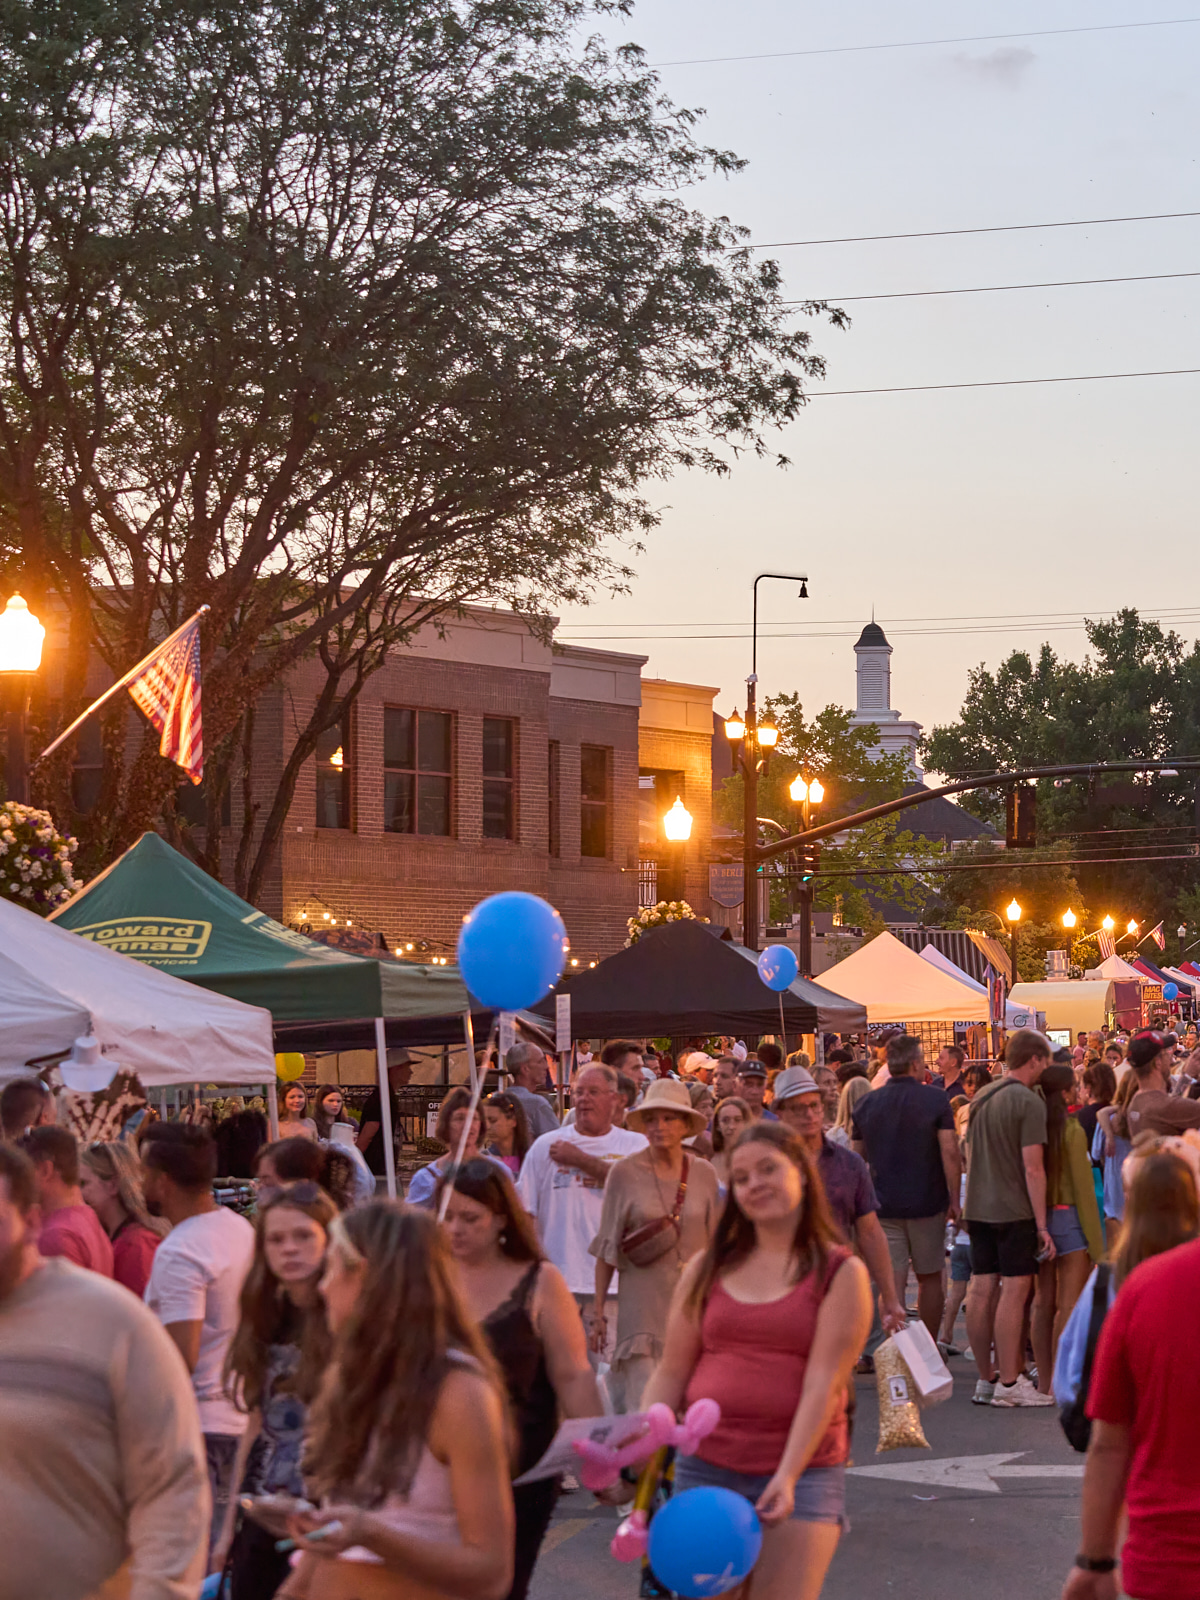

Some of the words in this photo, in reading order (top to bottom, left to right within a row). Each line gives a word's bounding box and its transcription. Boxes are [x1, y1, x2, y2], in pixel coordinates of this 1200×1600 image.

[103, 941, 169, 952] nna
[140, 958, 198, 966] ervices
[1144, 992, 1162, 1000] BITES
